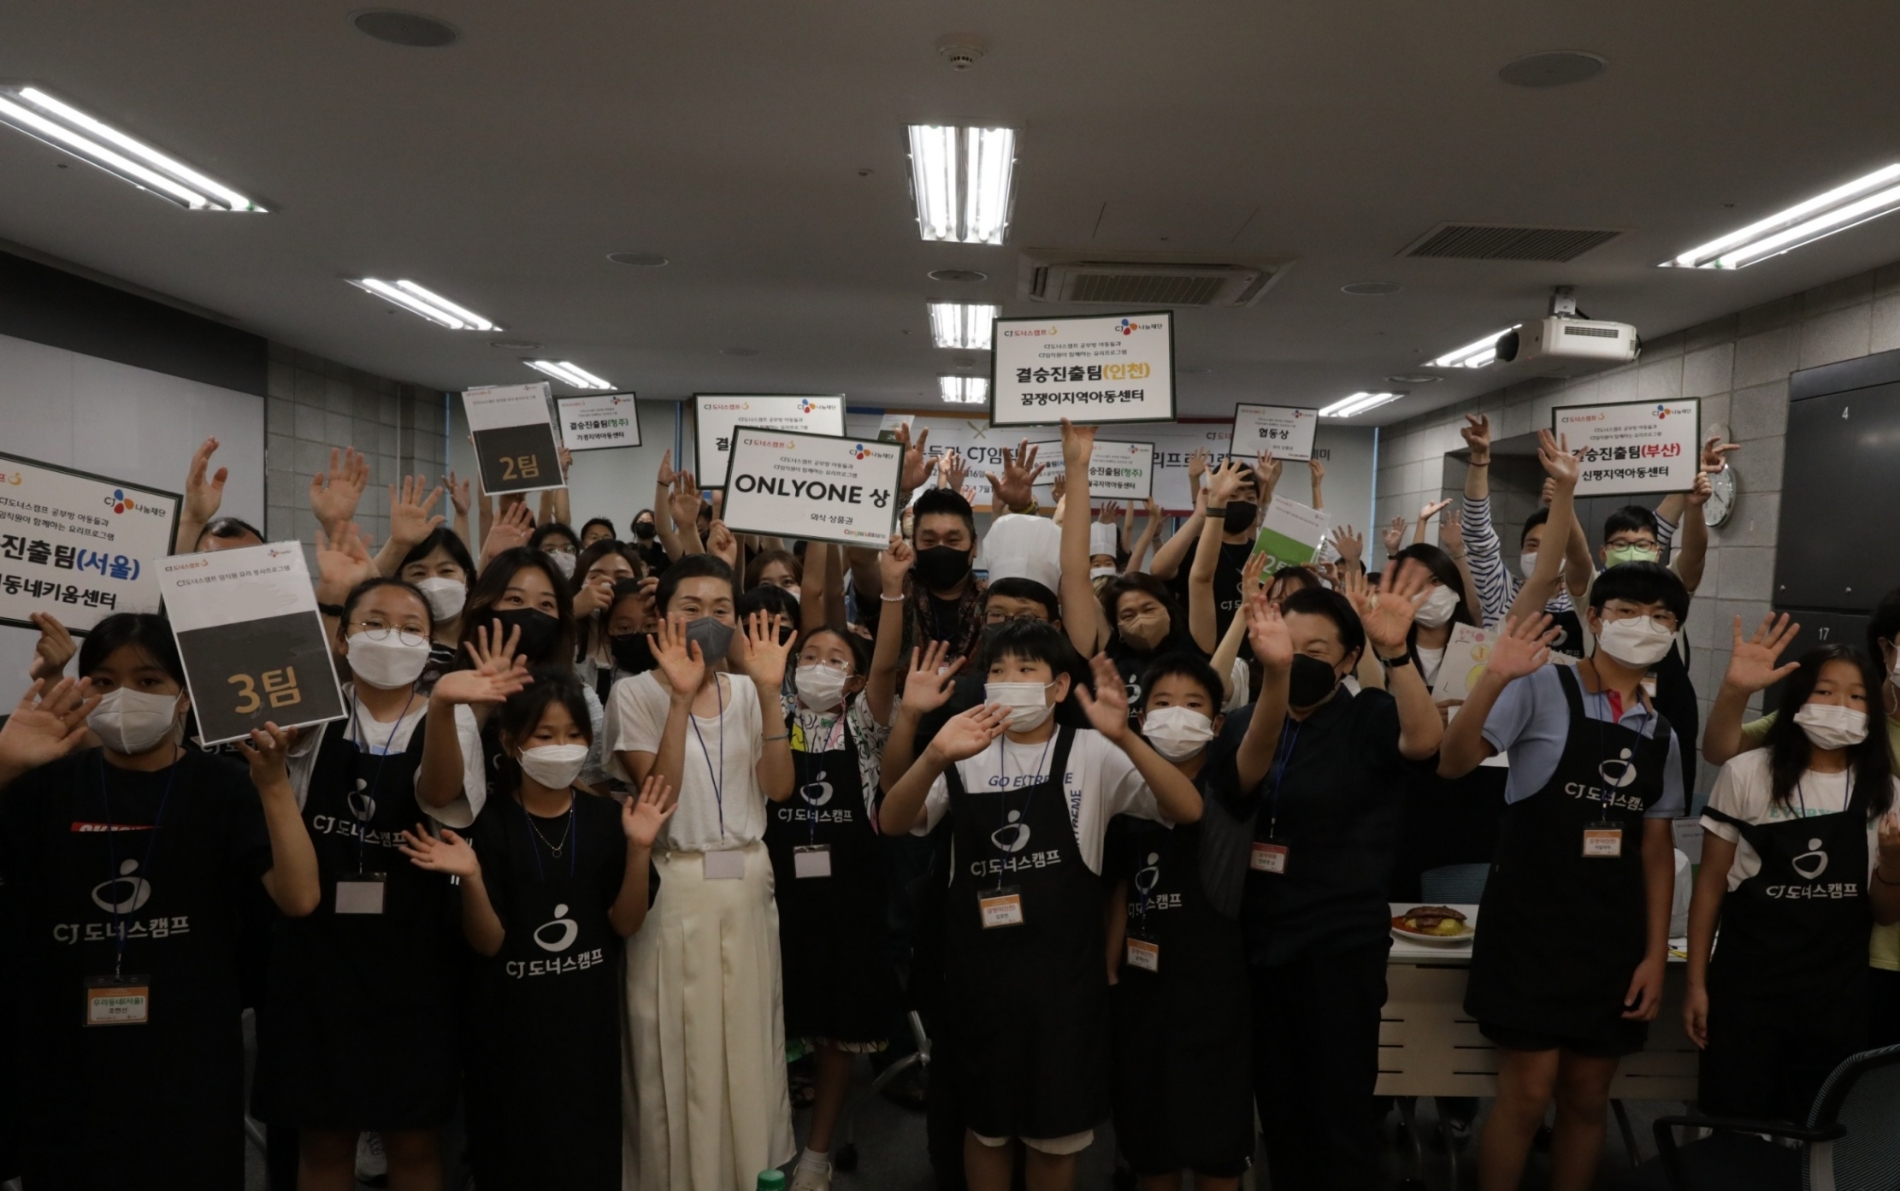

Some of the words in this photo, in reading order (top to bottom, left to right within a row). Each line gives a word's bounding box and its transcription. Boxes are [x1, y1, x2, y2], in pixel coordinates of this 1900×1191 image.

[1004, 330, 1013, 338] CJ
[1014, 329, 1047, 337] 도너스캠프
[1016, 362, 1151, 384] 결승진출팀(인천)
[1020, 389, 1145, 406] 꿈쟁이지역아동센터
[1841, 406, 1850, 420] 4
[1258, 427, 1290, 440] 협동상
[753, 440, 785, 449] 도너스캠프
[849, 449, 857, 457] CJ
[499, 454, 540, 480] 2팀
[1582, 466, 1669, 481] 신평지역아동센터
[735, 474, 863, 504] ONLYONE
[869, 488, 891, 509] 상
[104, 496, 116, 507] CJ
[135, 503, 166, 518] 나눔재단
[52, 508, 75, 521] 공부방
[78, 513, 109, 527] 아동들과
[810, 512, 827, 522] 외식
[828, 515, 854, 526] 상품권
[33, 517, 66, 532] 함께하는
[68, 525, 115, 541] 요리프로그램
[0, 533, 141, 581] 진출팀(서울)
[0, 573, 117, 611] 동네키움센터
[1220, 600, 1233, 611] CJ
[1818, 626, 1830, 641] 17
[227, 666, 302, 714] 3팀
[988, 775, 1010, 787] GO
[1565, 782, 1586, 799] CJ
[778, 808, 793, 822] CJ
[794, 809, 853, 823] 도너스캠프
[313, 814, 336, 834] CJ
[336, 820, 408, 848] 도너스캠프
[970, 861, 987, 877] CJ
[989, 849, 1061, 874] 도너스캠프
[1766, 885, 1786, 899] CJ
[1785, 883, 1858, 900] 도너스캠프
[53, 923, 80, 945] CJ
[84, 916, 190, 941] 도너스캠프
[506, 960, 526, 979] CJ
[528, 947, 604, 976] 도너스캠프
